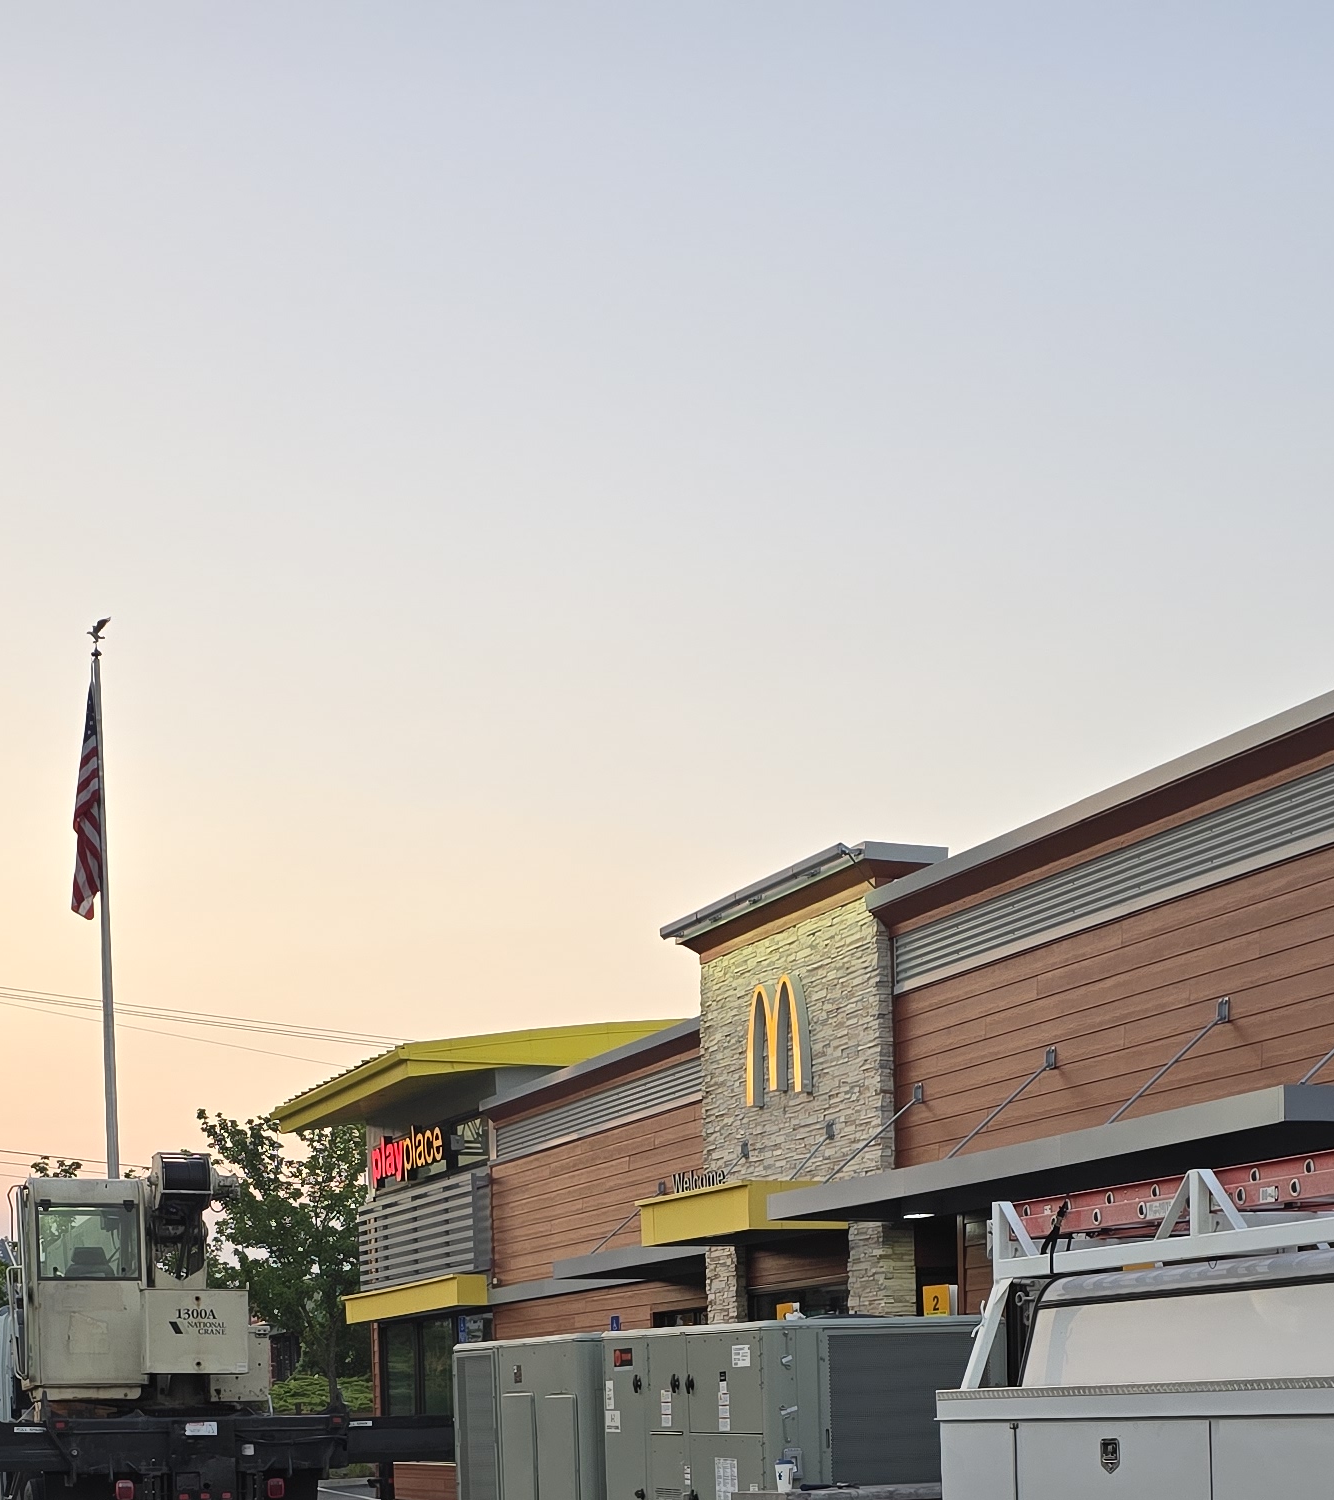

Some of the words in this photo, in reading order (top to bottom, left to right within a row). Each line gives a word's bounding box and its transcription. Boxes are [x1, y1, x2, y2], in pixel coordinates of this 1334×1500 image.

[672, 1169, 726, 1194] Welcome
[932, 1295, 940, 1312] 2
[175, 1308, 217, 1320] 1300A
[187, 1321, 226, 1329] NATIONAL
